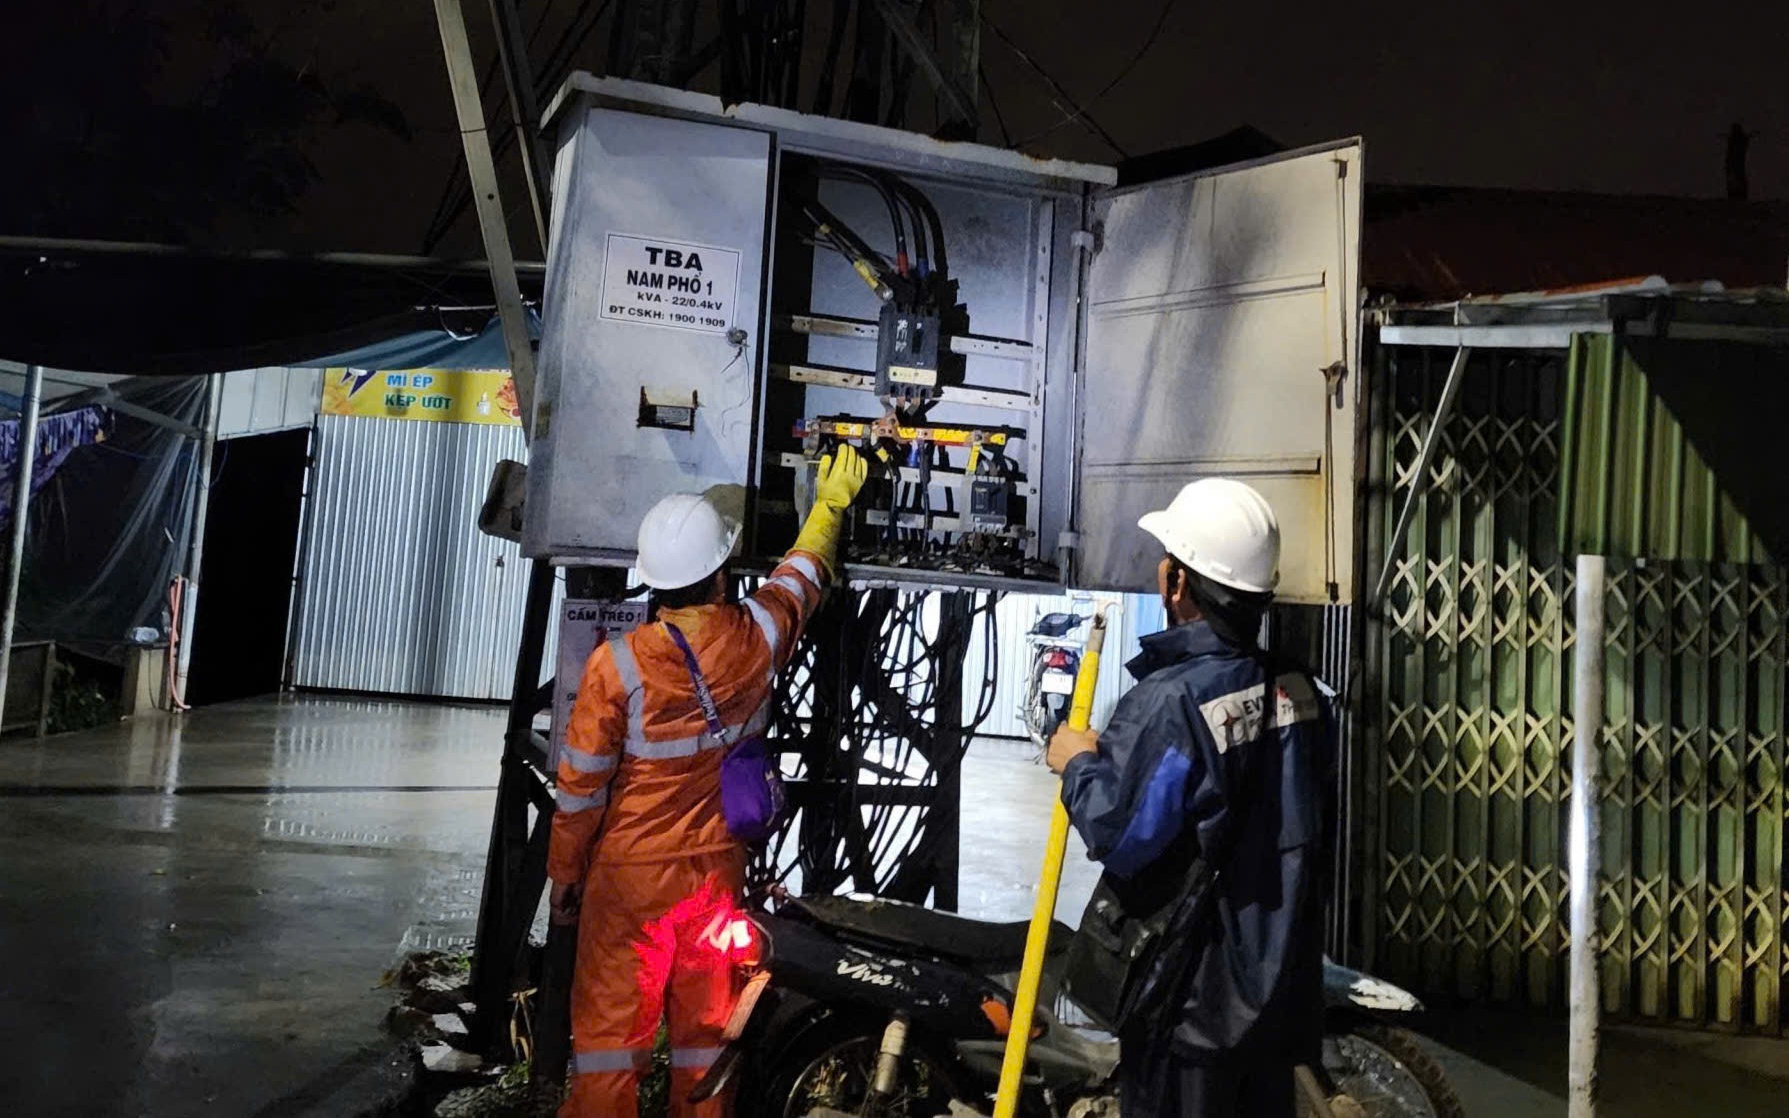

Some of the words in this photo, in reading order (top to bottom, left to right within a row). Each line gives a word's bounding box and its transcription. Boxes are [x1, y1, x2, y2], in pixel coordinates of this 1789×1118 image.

[645, 246, 703, 271] TBA
[626, 269, 664, 290] NAM
[667, 271, 702, 294] PHỔ
[706, 280, 713, 296] 1
[637, 292, 662, 303] kVA
[672, 295, 723, 311] 22/0.4kV
[608, 304, 626, 315] ĐT
[628, 306, 665, 320] CSKH:
[669, 313, 696, 324] 1900
[700, 316, 726, 328] 1909
